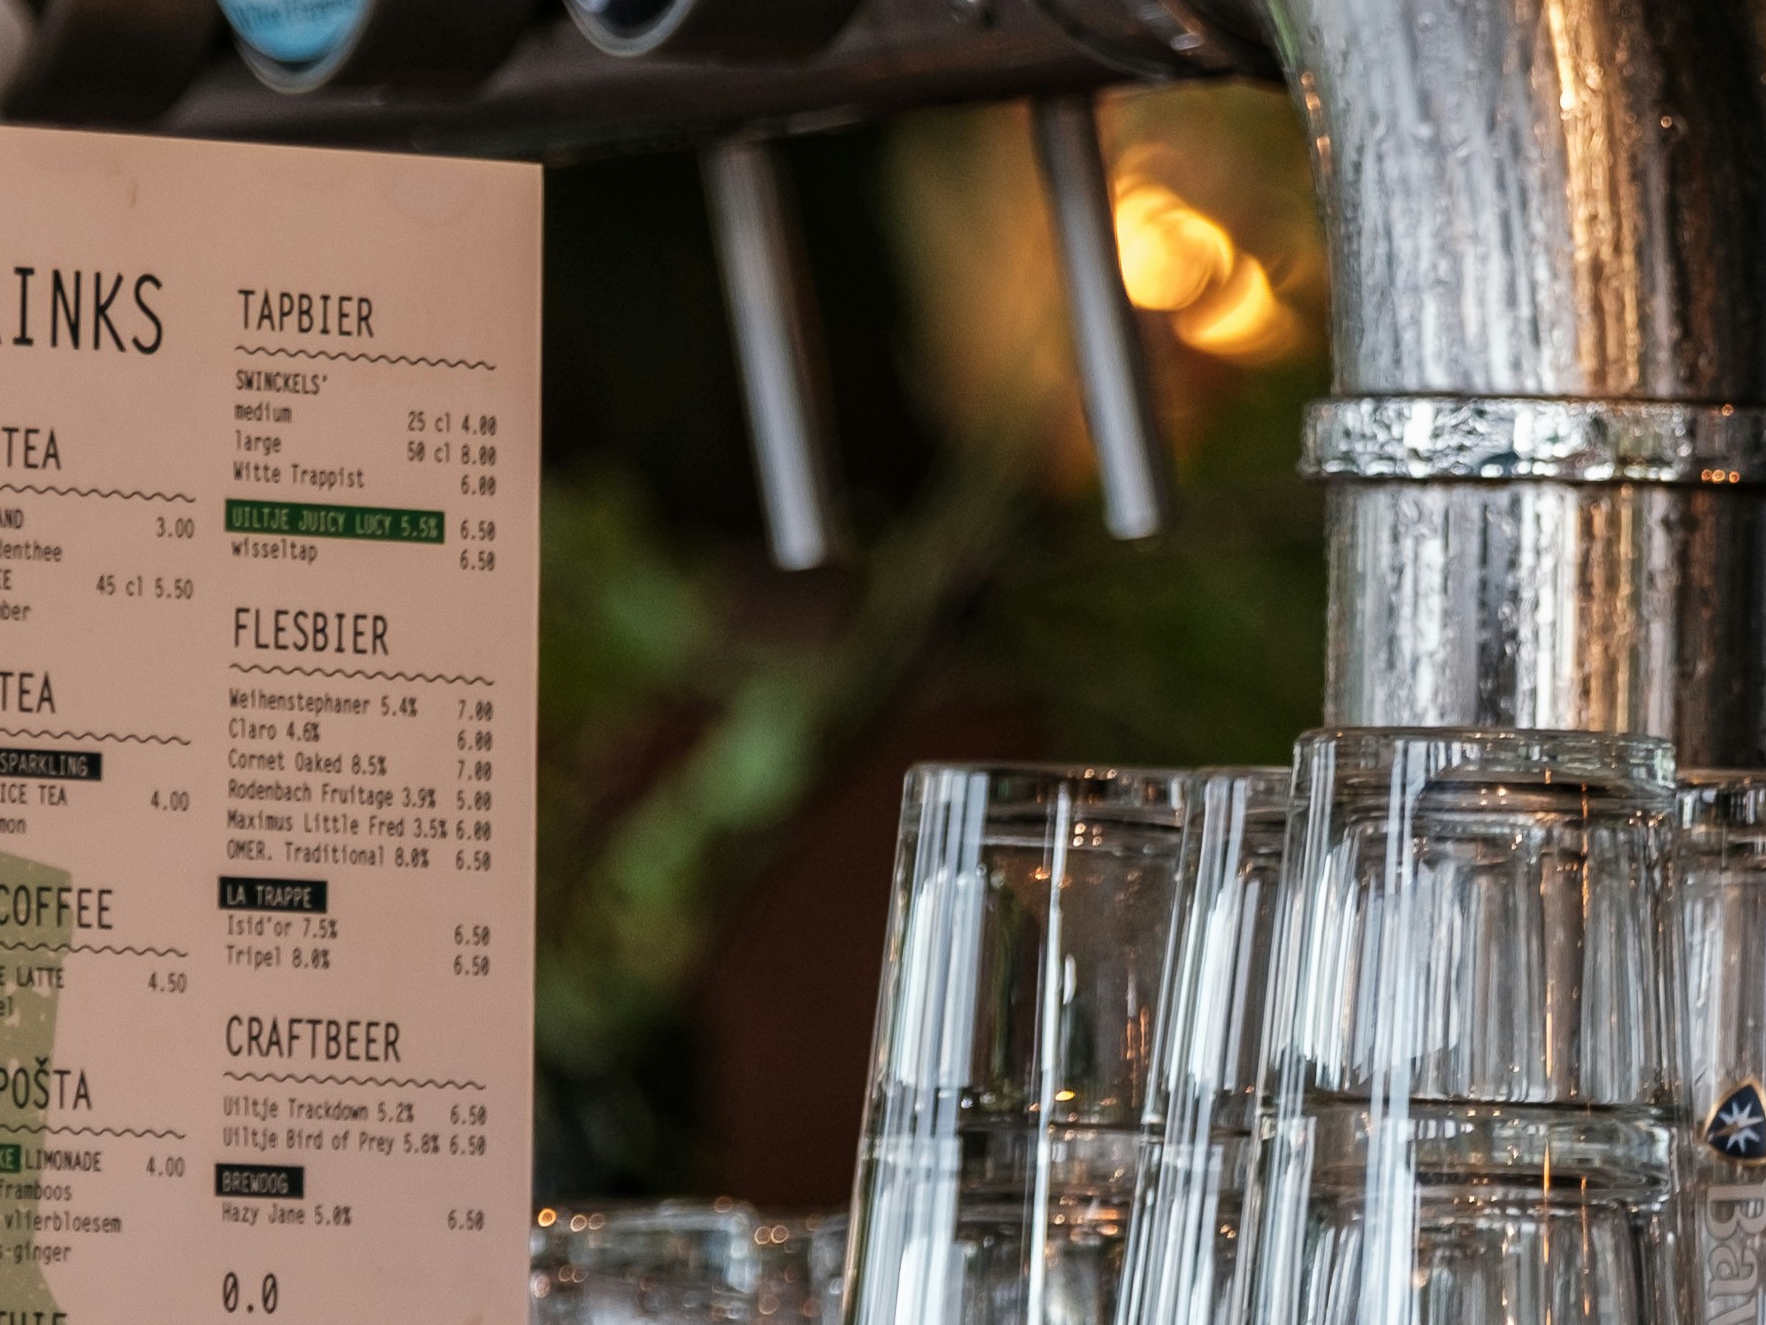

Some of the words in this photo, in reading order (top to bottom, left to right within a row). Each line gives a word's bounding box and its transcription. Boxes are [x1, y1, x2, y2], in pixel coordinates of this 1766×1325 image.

[237, 288, 374, 337] TAPBIER
[236, 369, 328, 395] SWINCKELS'
[234, 402, 292, 422] medium
[461, 414, 497, 436] 4.00
[1, 426, 61, 469] TEA
[235, 429, 282, 456] large
[461, 444, 497, 465] 8.00
[233, 461, 281, 483] Witte
[290, 463, 365, 489] Trappist
[460, 474, 497, 496] 6.00
[156, 516, 195, 539] 3.00
[297, 509, 346, 532] JUICY
[355, 512, 393, 535] LUCY
[460, 519, 496, 541] 6.50
[231, 537, 318, 563] wisseltap
[154, 577, 194, 599] 5.50
[234, 607, 389, 655] FLESBIER
[228, 688, 371, 715] Weihenstephaner
[459, 699, 494, 721] 7.00
[228, 717, 277, 740] Claro
[457, 729, 493, 751] 6.00
[228, 748, 285, 770] Cornet
[295, 751, 342, 773] Oaked
[0, 782, 27, 804] ICE
[38, 784, 67, 805] TEA
[150, 790, 190, 811] 4.00
[228, 778, 312, 801] Rodenbach
[321, 782, 394, 809] Fruitage
[227, 809, 293, 831] Maximus
[304, 813, 360, 834] Little
[369, 814, 405, 837] Fred
[284, 840, 384, 866] Traditional
[226, 885, 246, 905] LA
[255, 884, 313, 908] TRAPPE
[227, 914, 293, 937] Isid'or
[454, 924, 491, 946] 6.50
[226, 944, 281, 969] Tripel
[15, 966, 65, 989] LATTE
[148, 972, 187, 993] 4.50
[225, 1014, 401, 1061] CRAFTBEER
[288, 1097, 369, 1120] Trackdown
[286, 1128, 323, 1150] Bird
[359, 1131, 395, 1155] Prey
[24, 1149, 103, 1172] LIMONADE
[146, 1156, 185, 1177] 4.00
[3, 1208, 123, 1233] vlierbloesem
[222, 1203, 260, 1226] Hazy
[268, 1203, 306, 1224] Jane
[222, 1271, 279, 1314] 0.0
